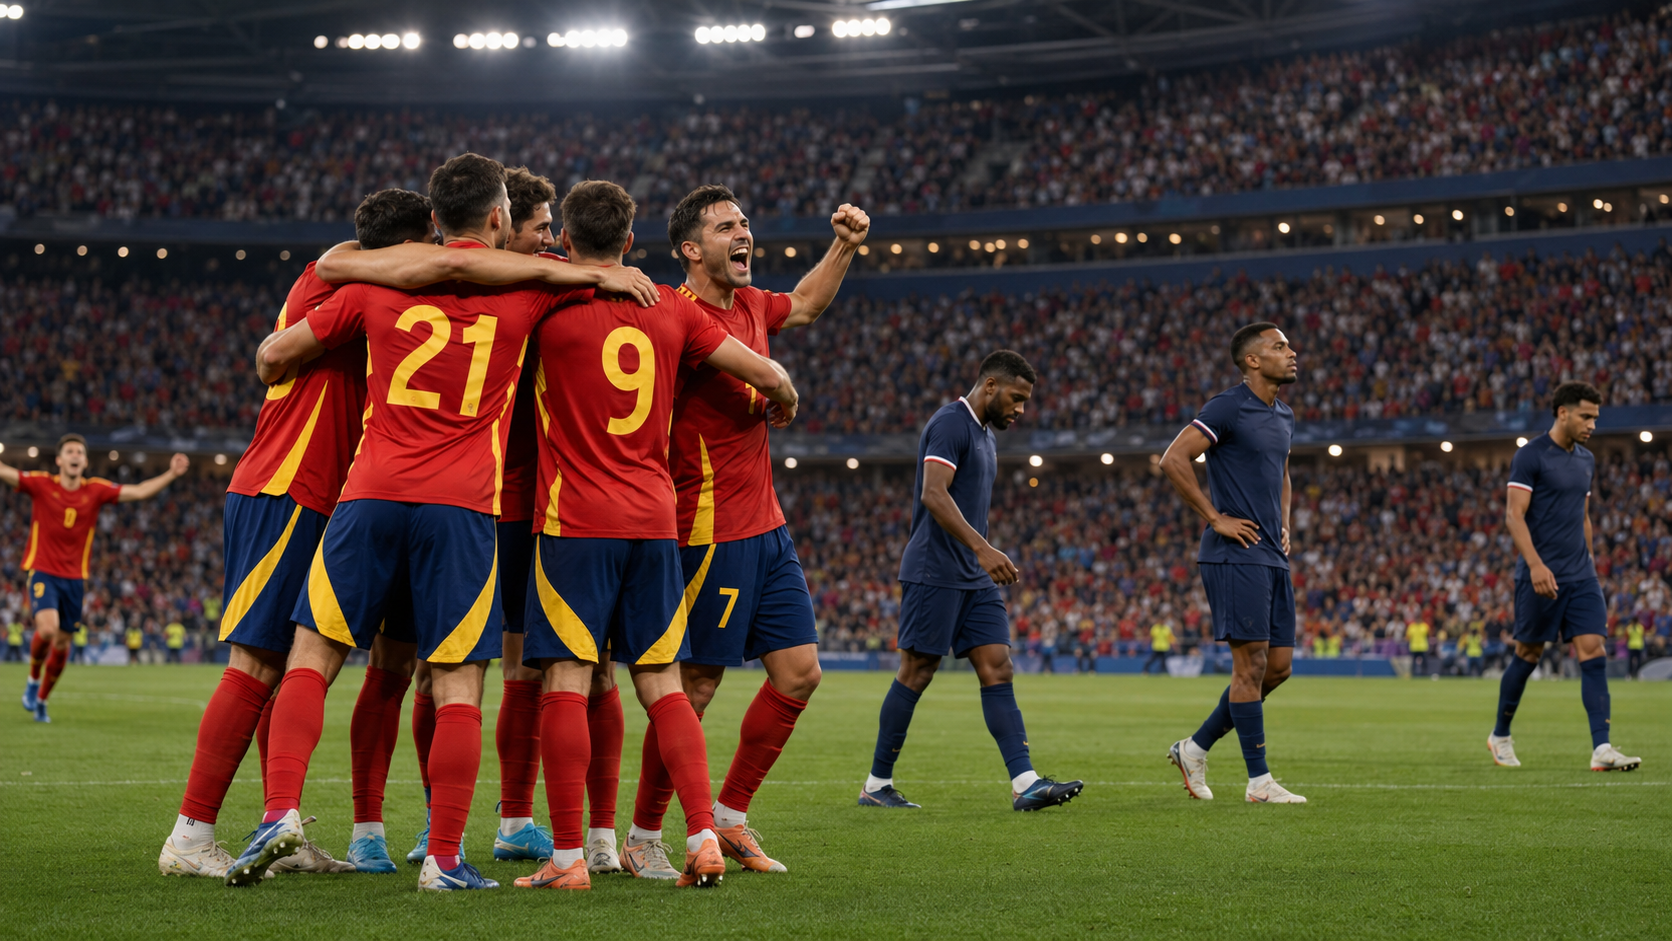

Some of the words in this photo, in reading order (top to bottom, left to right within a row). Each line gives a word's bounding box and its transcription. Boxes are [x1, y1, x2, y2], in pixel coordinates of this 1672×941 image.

[386, 304, 498, 418] 21
[601, 326, 656, 436] 9
[717, 587, 740, 629] 7
